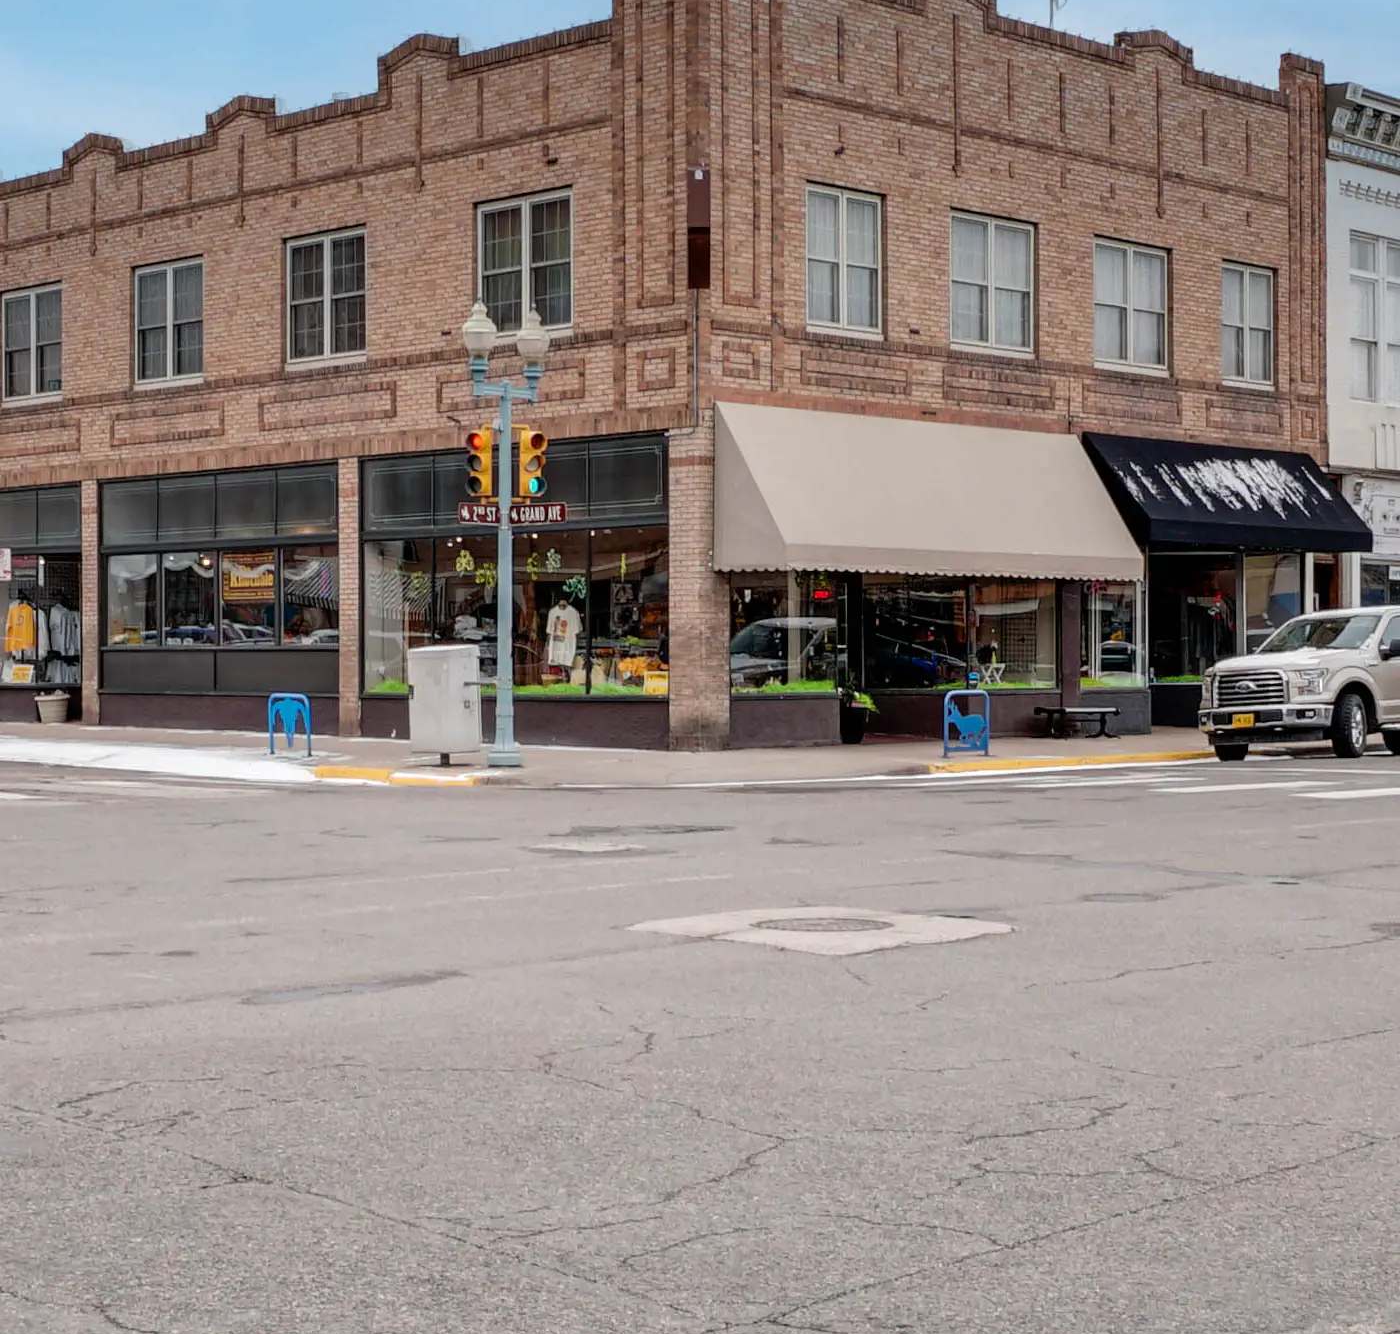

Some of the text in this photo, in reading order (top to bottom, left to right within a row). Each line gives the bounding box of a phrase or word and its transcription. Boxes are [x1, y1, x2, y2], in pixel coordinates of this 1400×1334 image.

[473, 506, 496, 522] 2ND ST
[520, 506, 562, 522] GRAND AVE
